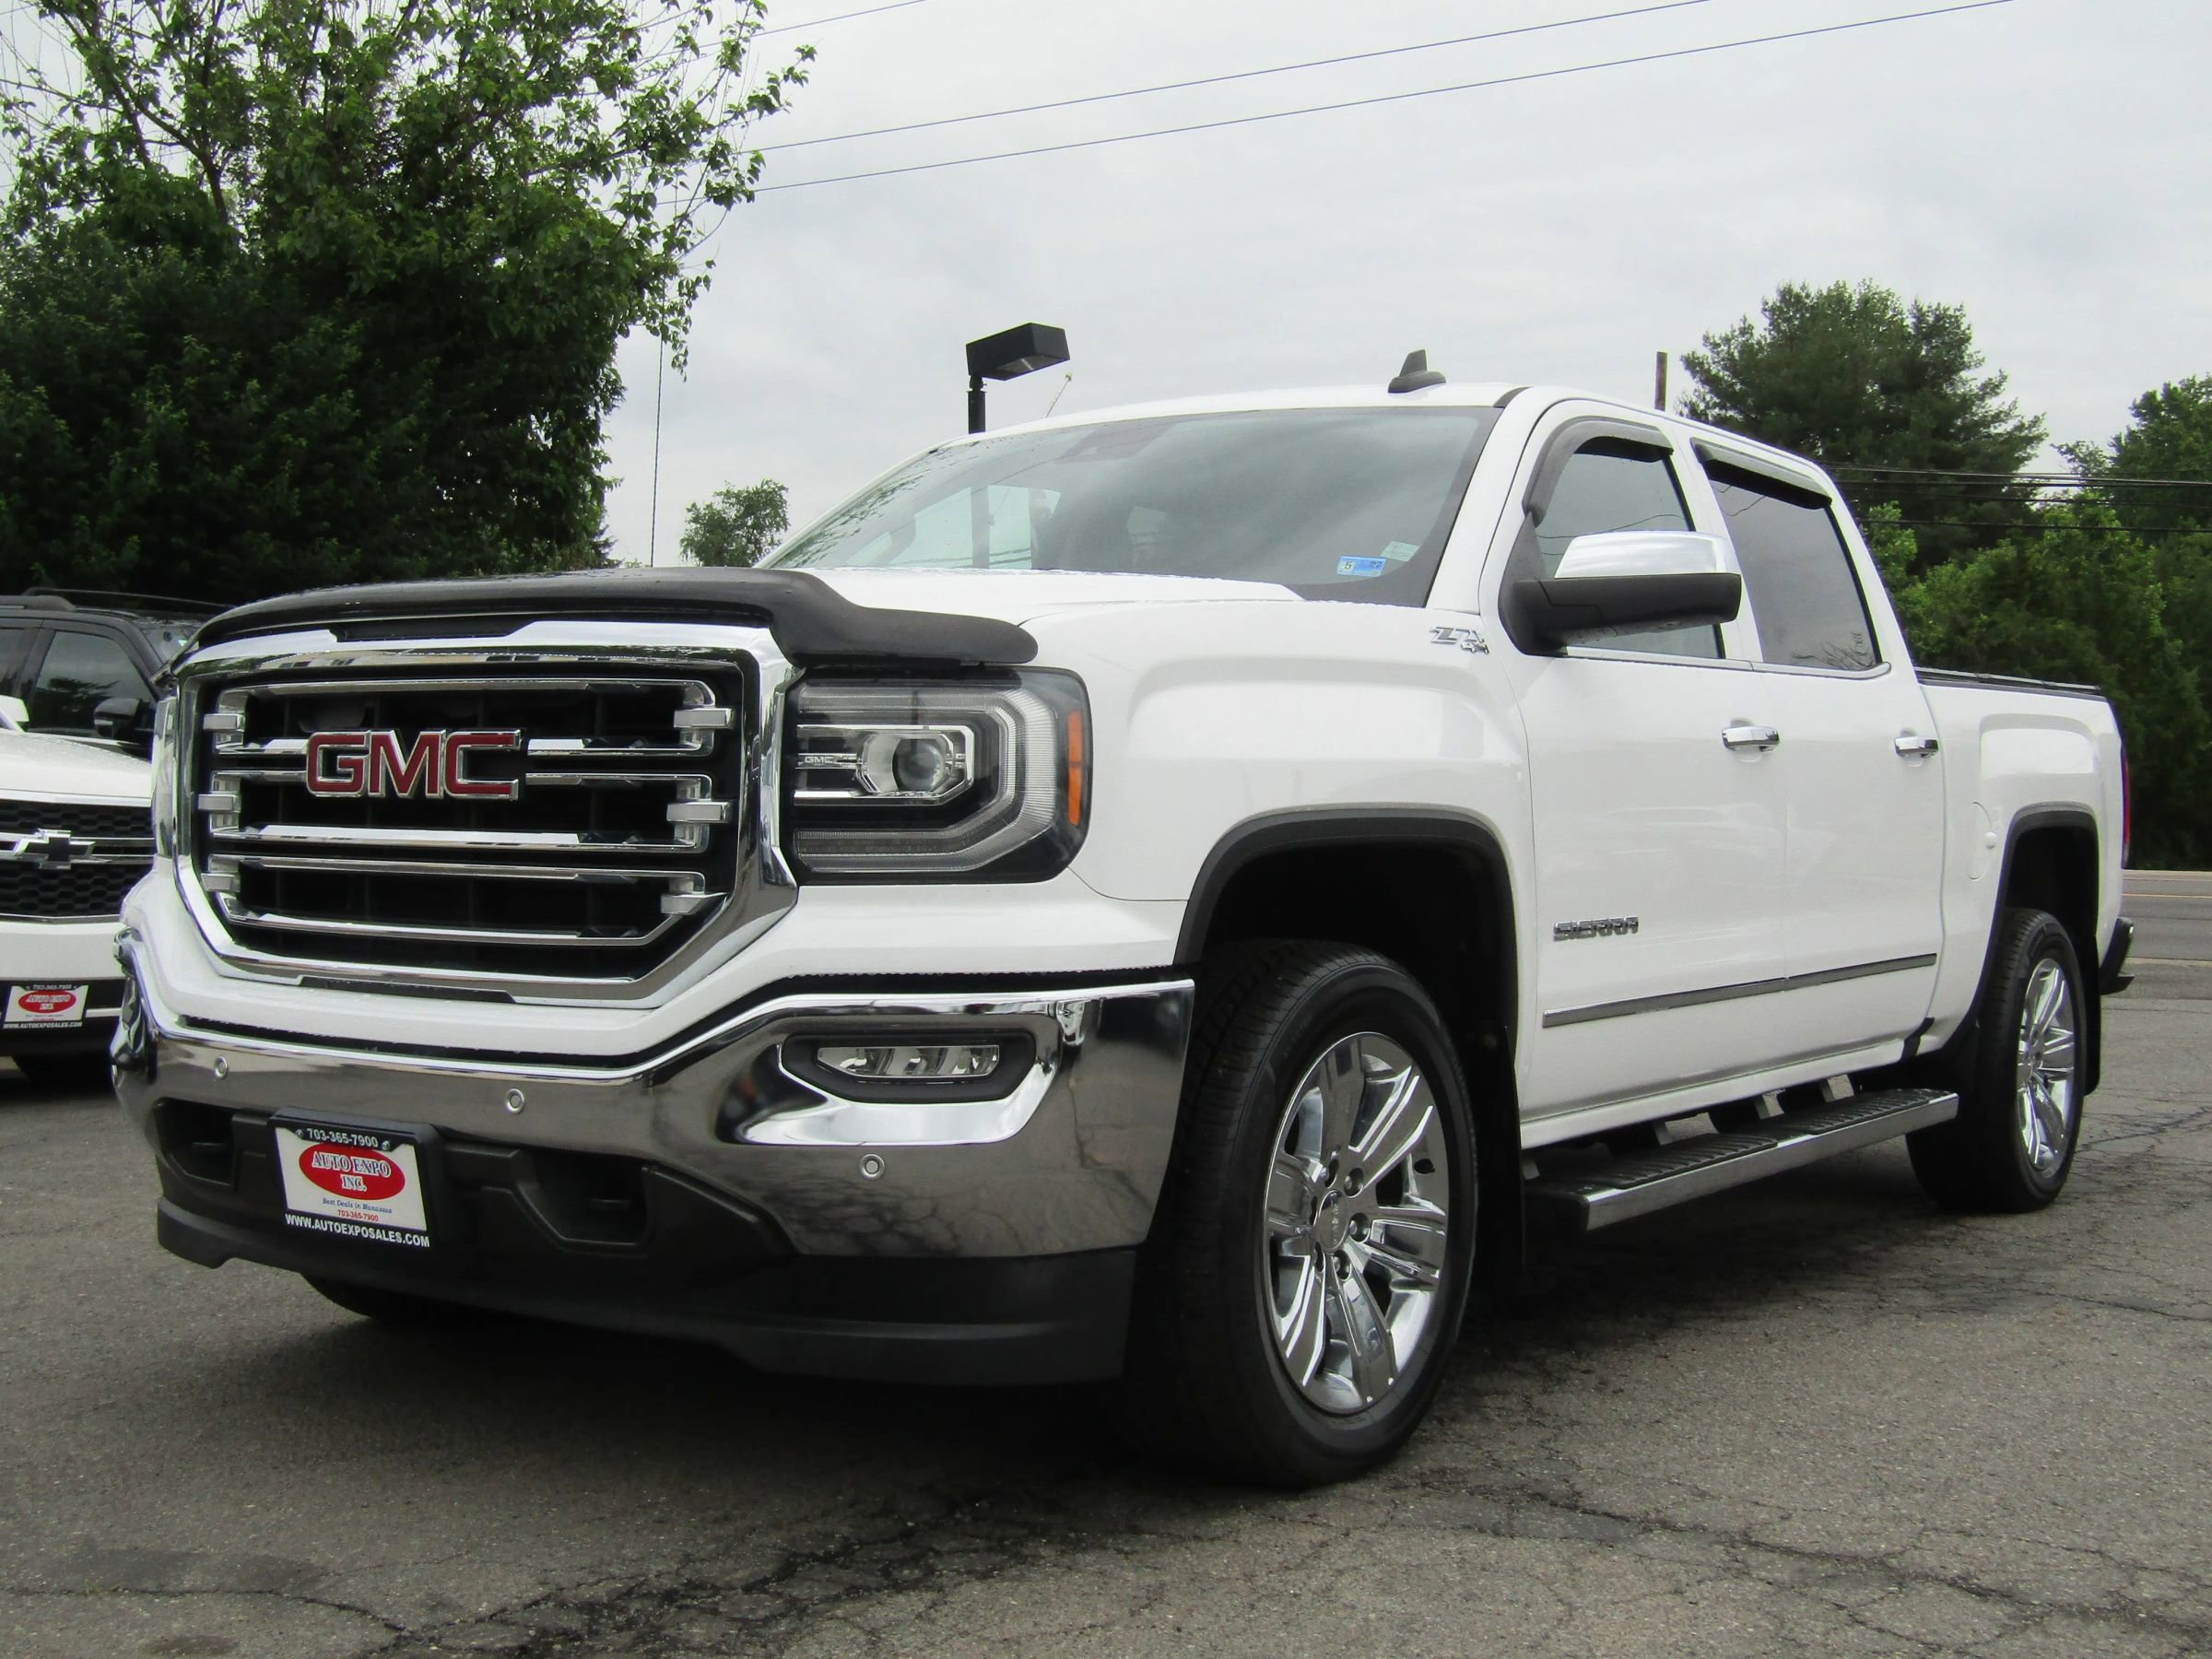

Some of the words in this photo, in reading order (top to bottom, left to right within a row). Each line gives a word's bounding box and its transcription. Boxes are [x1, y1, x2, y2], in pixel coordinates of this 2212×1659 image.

[306, 729, 522, 801] GMC
[805, 756, 834, 764] GMC
[1553, 916, 1639, 942] SIERRA
[307, 1128, 379, 1148] 703-365-7900
[312, 1151, 351, 1172] AUTO
[352, 1155, 392, 1179] EXPO
[341, 1173, 367, 1192] INC.
[323, 1198, 335, 1206] Best
[337, 1200, 353, 1209] Deals
[355, 1202, 361, 1210] in
[337, 1209, 379, 1222] 703-365-7900
[285, 1213, 430, 1248] WWW.AUTOEXPOSALES.COM
